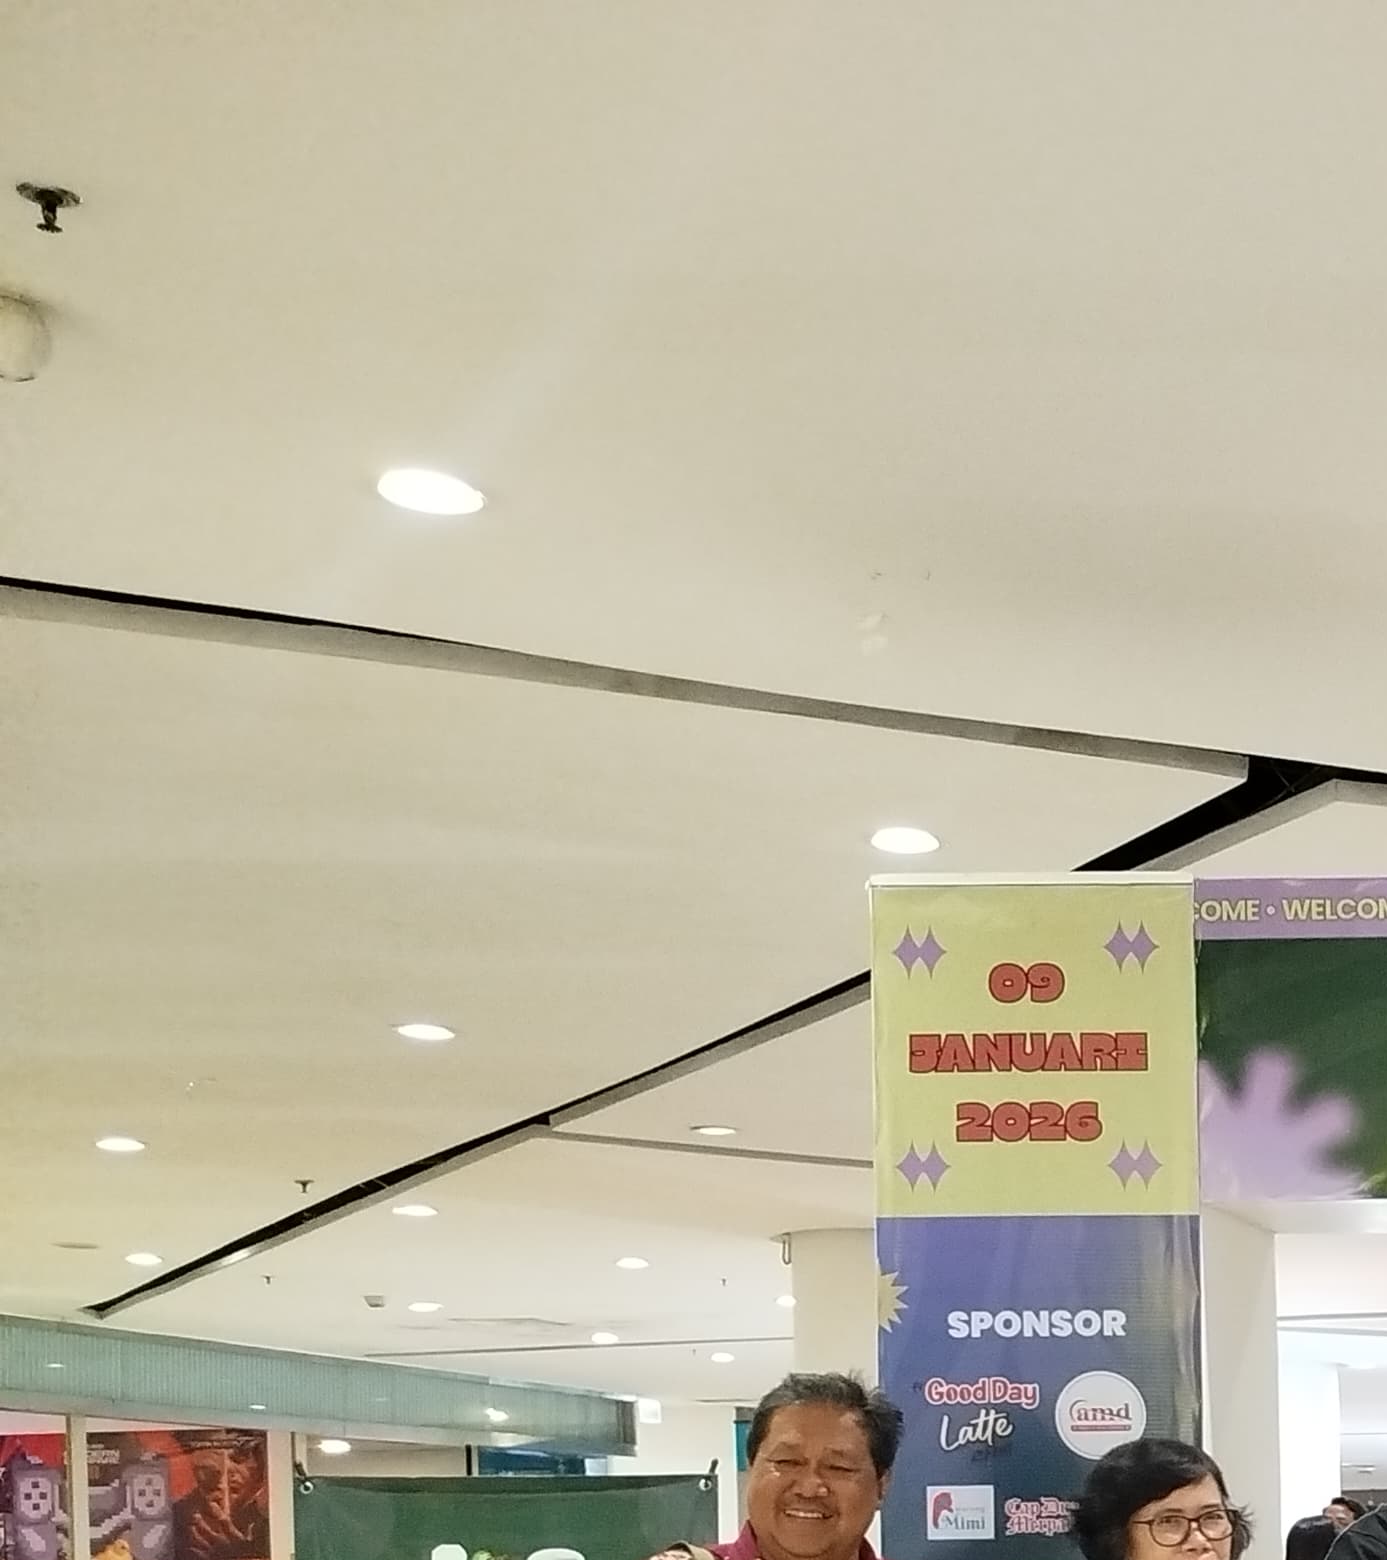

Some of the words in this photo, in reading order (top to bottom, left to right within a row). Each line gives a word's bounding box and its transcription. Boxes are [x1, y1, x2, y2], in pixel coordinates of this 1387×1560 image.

[988, 963, 1065, 1003] 09
[908, 1032, 1149, 1073] JANUARI
[956, 1102, 1103, 1142] 2026
[947, 1309, 1127, 1339] SPONSOR
[925, 1377, 989, 1405] Good
[990, 1376, 1040, 1409] Day
[939, 1408, 1014, 1451] Latte
